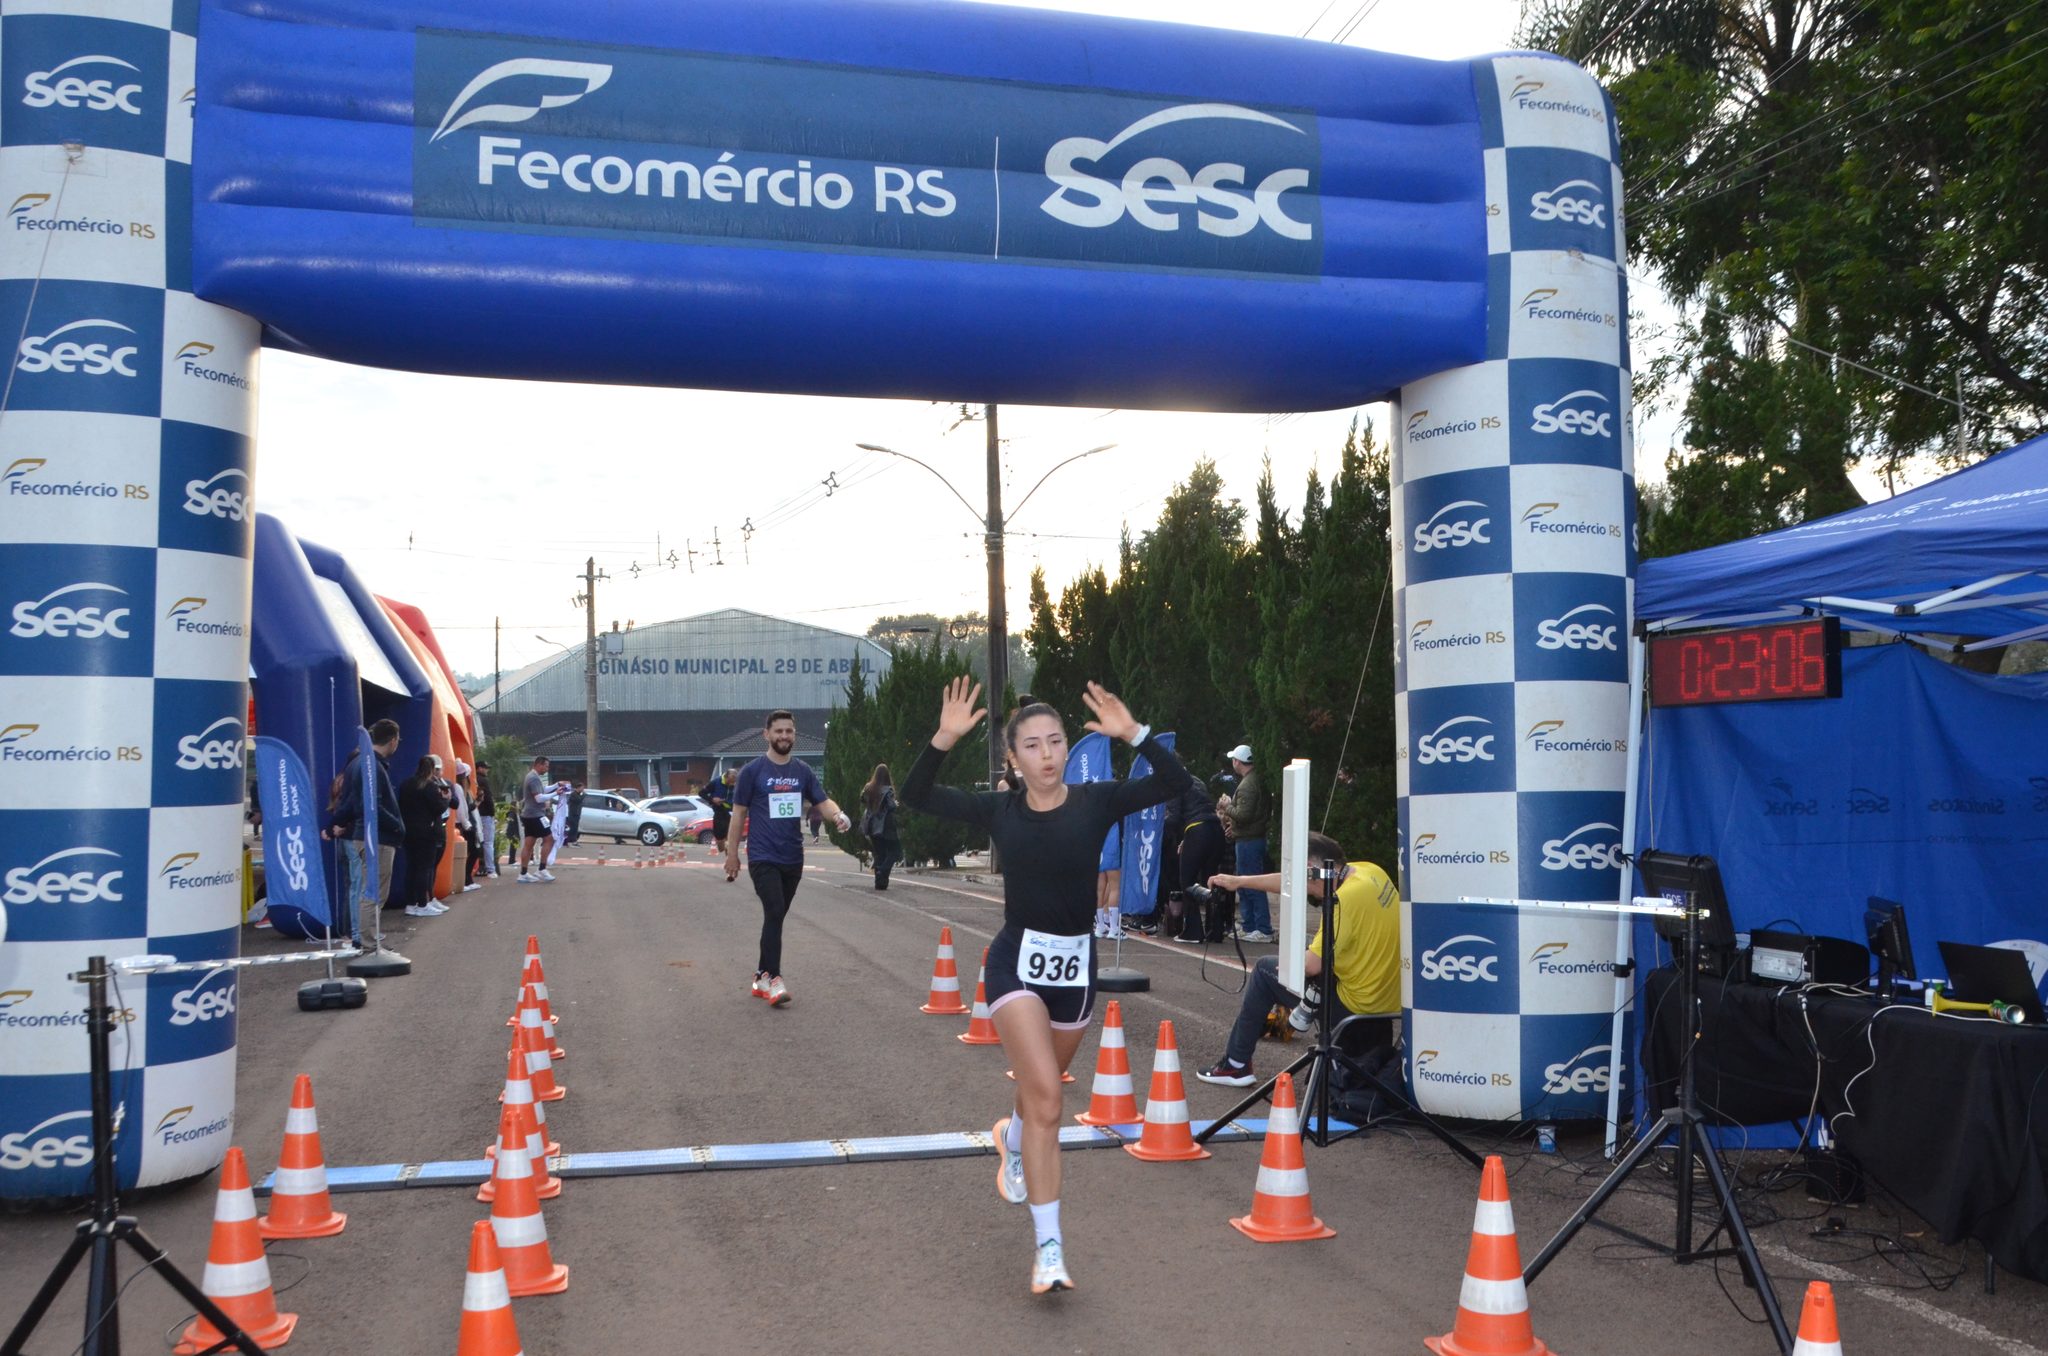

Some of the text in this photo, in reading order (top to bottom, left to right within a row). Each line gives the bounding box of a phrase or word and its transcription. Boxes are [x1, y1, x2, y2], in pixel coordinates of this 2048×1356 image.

[22, 71, 142, 115] Sesc
[1519, 98, 1604, 123] Fecomércio RS
[479, 136, 957, 217] Fecomércio RS
[1040, 137, 1312, 240] Sesc
[1530, 191, 1605, 229] Sesc
[16, 216, 156, 239] Fecomércio RS
[1529, 306, 1616, 327] Fecomércio RS
[17, 336, 138, 377] Sesc
[1409, 416, 1501, 443] Fecomércio RS
[1531, 404, 1611, 438] Sesc
[10, 481, 149, 500] Fecomércio RS
[1414, 518, 1491, 553] Sesc
[1530, 521, 1621, 537] Fecomércio RS
[9, 601, 130, 639] Sesc
[176, 618, 243, 637] Fecomércio
[1414, 633, 1481, 652] Fecomércio
[1485, 631, 1506, 644] RS
[1536, 619, 1617, 651] Sesc
[599, 656, 669, 675] GINÁSIO
[674, 658, 769, 674] MUNICIPAL
[775, 658, 797, 674] 29
[802, 658, 823, 674] DE
[1680, 626, 1825, 699] 0:23:06
[3, 746, 143, 761] Fecomércio RS
[1417, 735, 1495, 765] Sesc
[1535, 739, 1627, 752] Fecomércio RS
[279, 759, 290, 818] Fecomércio
[778, 803, 794, 816] 65
[286, 826, 309, 891] Sesc
[1417, 851, 1485, 864] Fecomércio
[1489, 851, 1510, 864] RS
[3, 867, 123, 904] Sesc
[169, 870, 235, 889] Fecomércio
[1028, 952, 1080, 981] 936
[1421, 950, 1498, 982] Sesc
[1538, 960, 1616, 974] Fecomércio
[1419, 1068, 1487, 1086] Fecomércio
[1491, 1073, 1512, 1086] RS
[163, 1118, 228, 1146] Fecomércio
[0, 1133, 94, 1170] Ses
